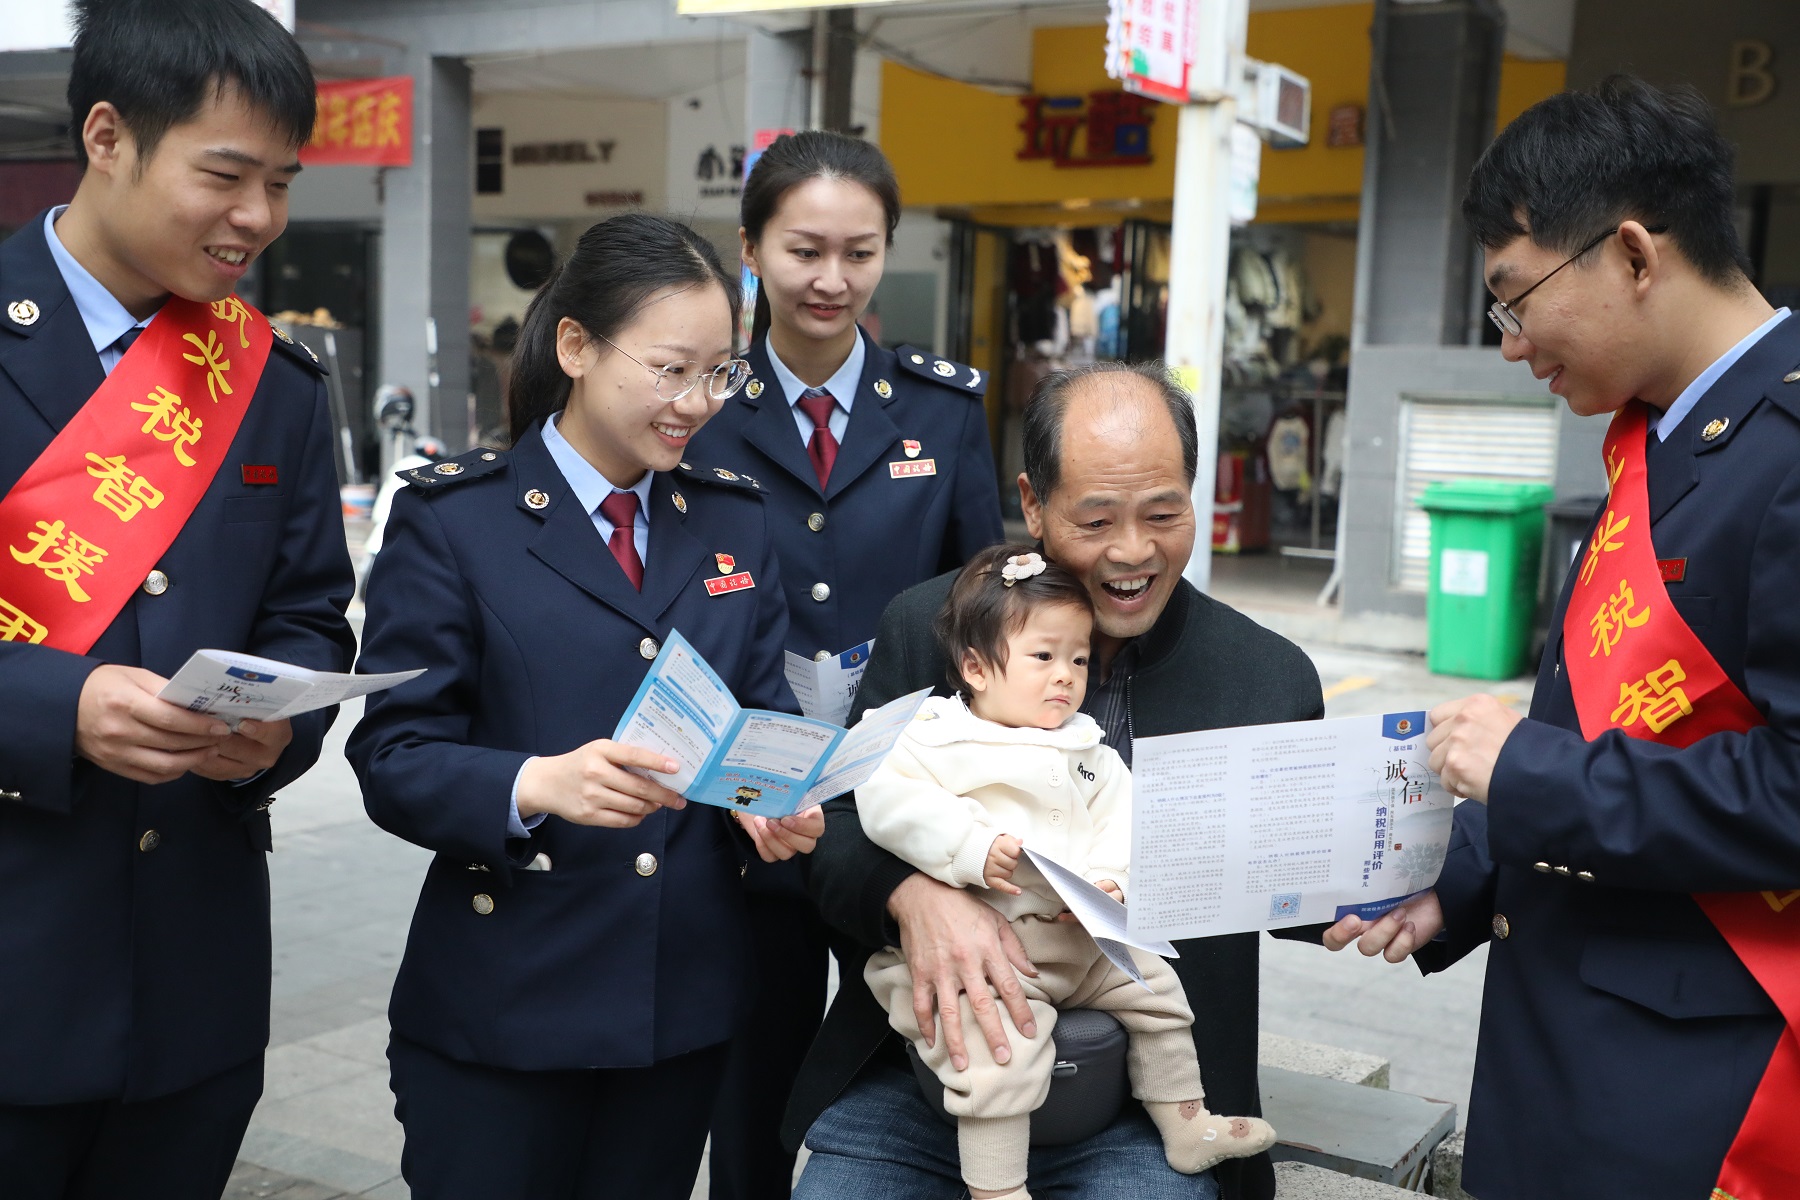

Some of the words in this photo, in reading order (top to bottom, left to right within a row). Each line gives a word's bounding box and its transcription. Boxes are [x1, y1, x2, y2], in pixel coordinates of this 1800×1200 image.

[1729, 40, 1773, 106] B
[1385, 758, 1424, 805] 诚信
[1371, 806, 1388, 871] 纳税信用评价
[1362, 860, 1371, 888] 那些事儿
